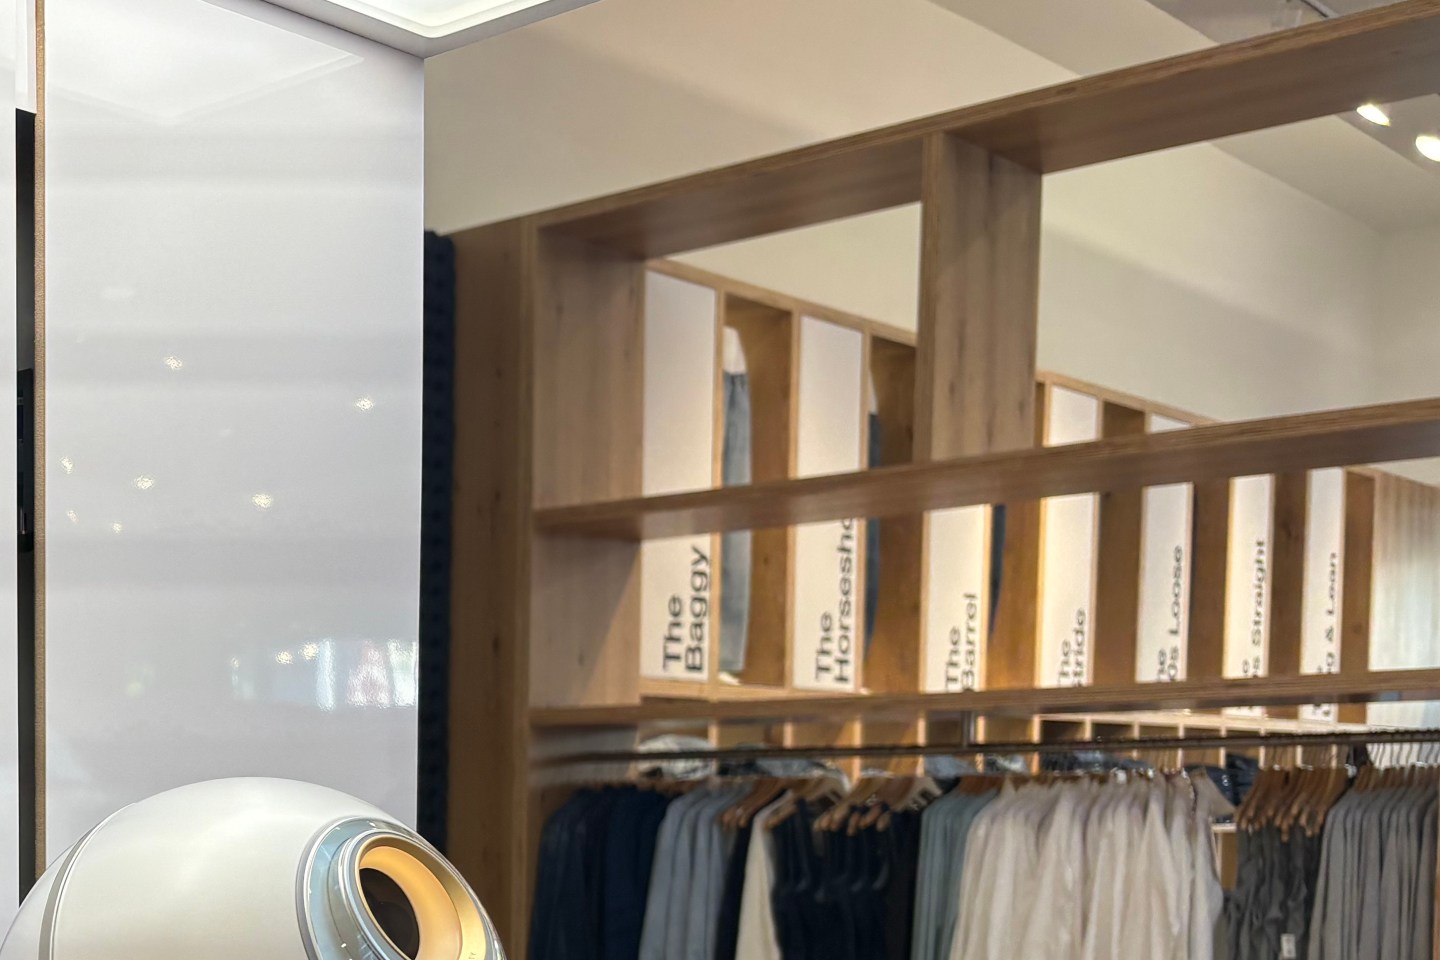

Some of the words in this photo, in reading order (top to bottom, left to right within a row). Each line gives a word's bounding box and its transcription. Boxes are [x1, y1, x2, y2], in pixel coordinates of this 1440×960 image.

[685, 545, 712, 673] Baggy
[1168, 545, 1182, 637] Loose
[662, 594, 683, 672] The
[815, 611, 833, 681] The
[945, 627, 961, 692] The
[961, 592, 978, 692] Barrel
[1058, 639, 1071, 687] he
[1072, 608, 1086, 688] tride
